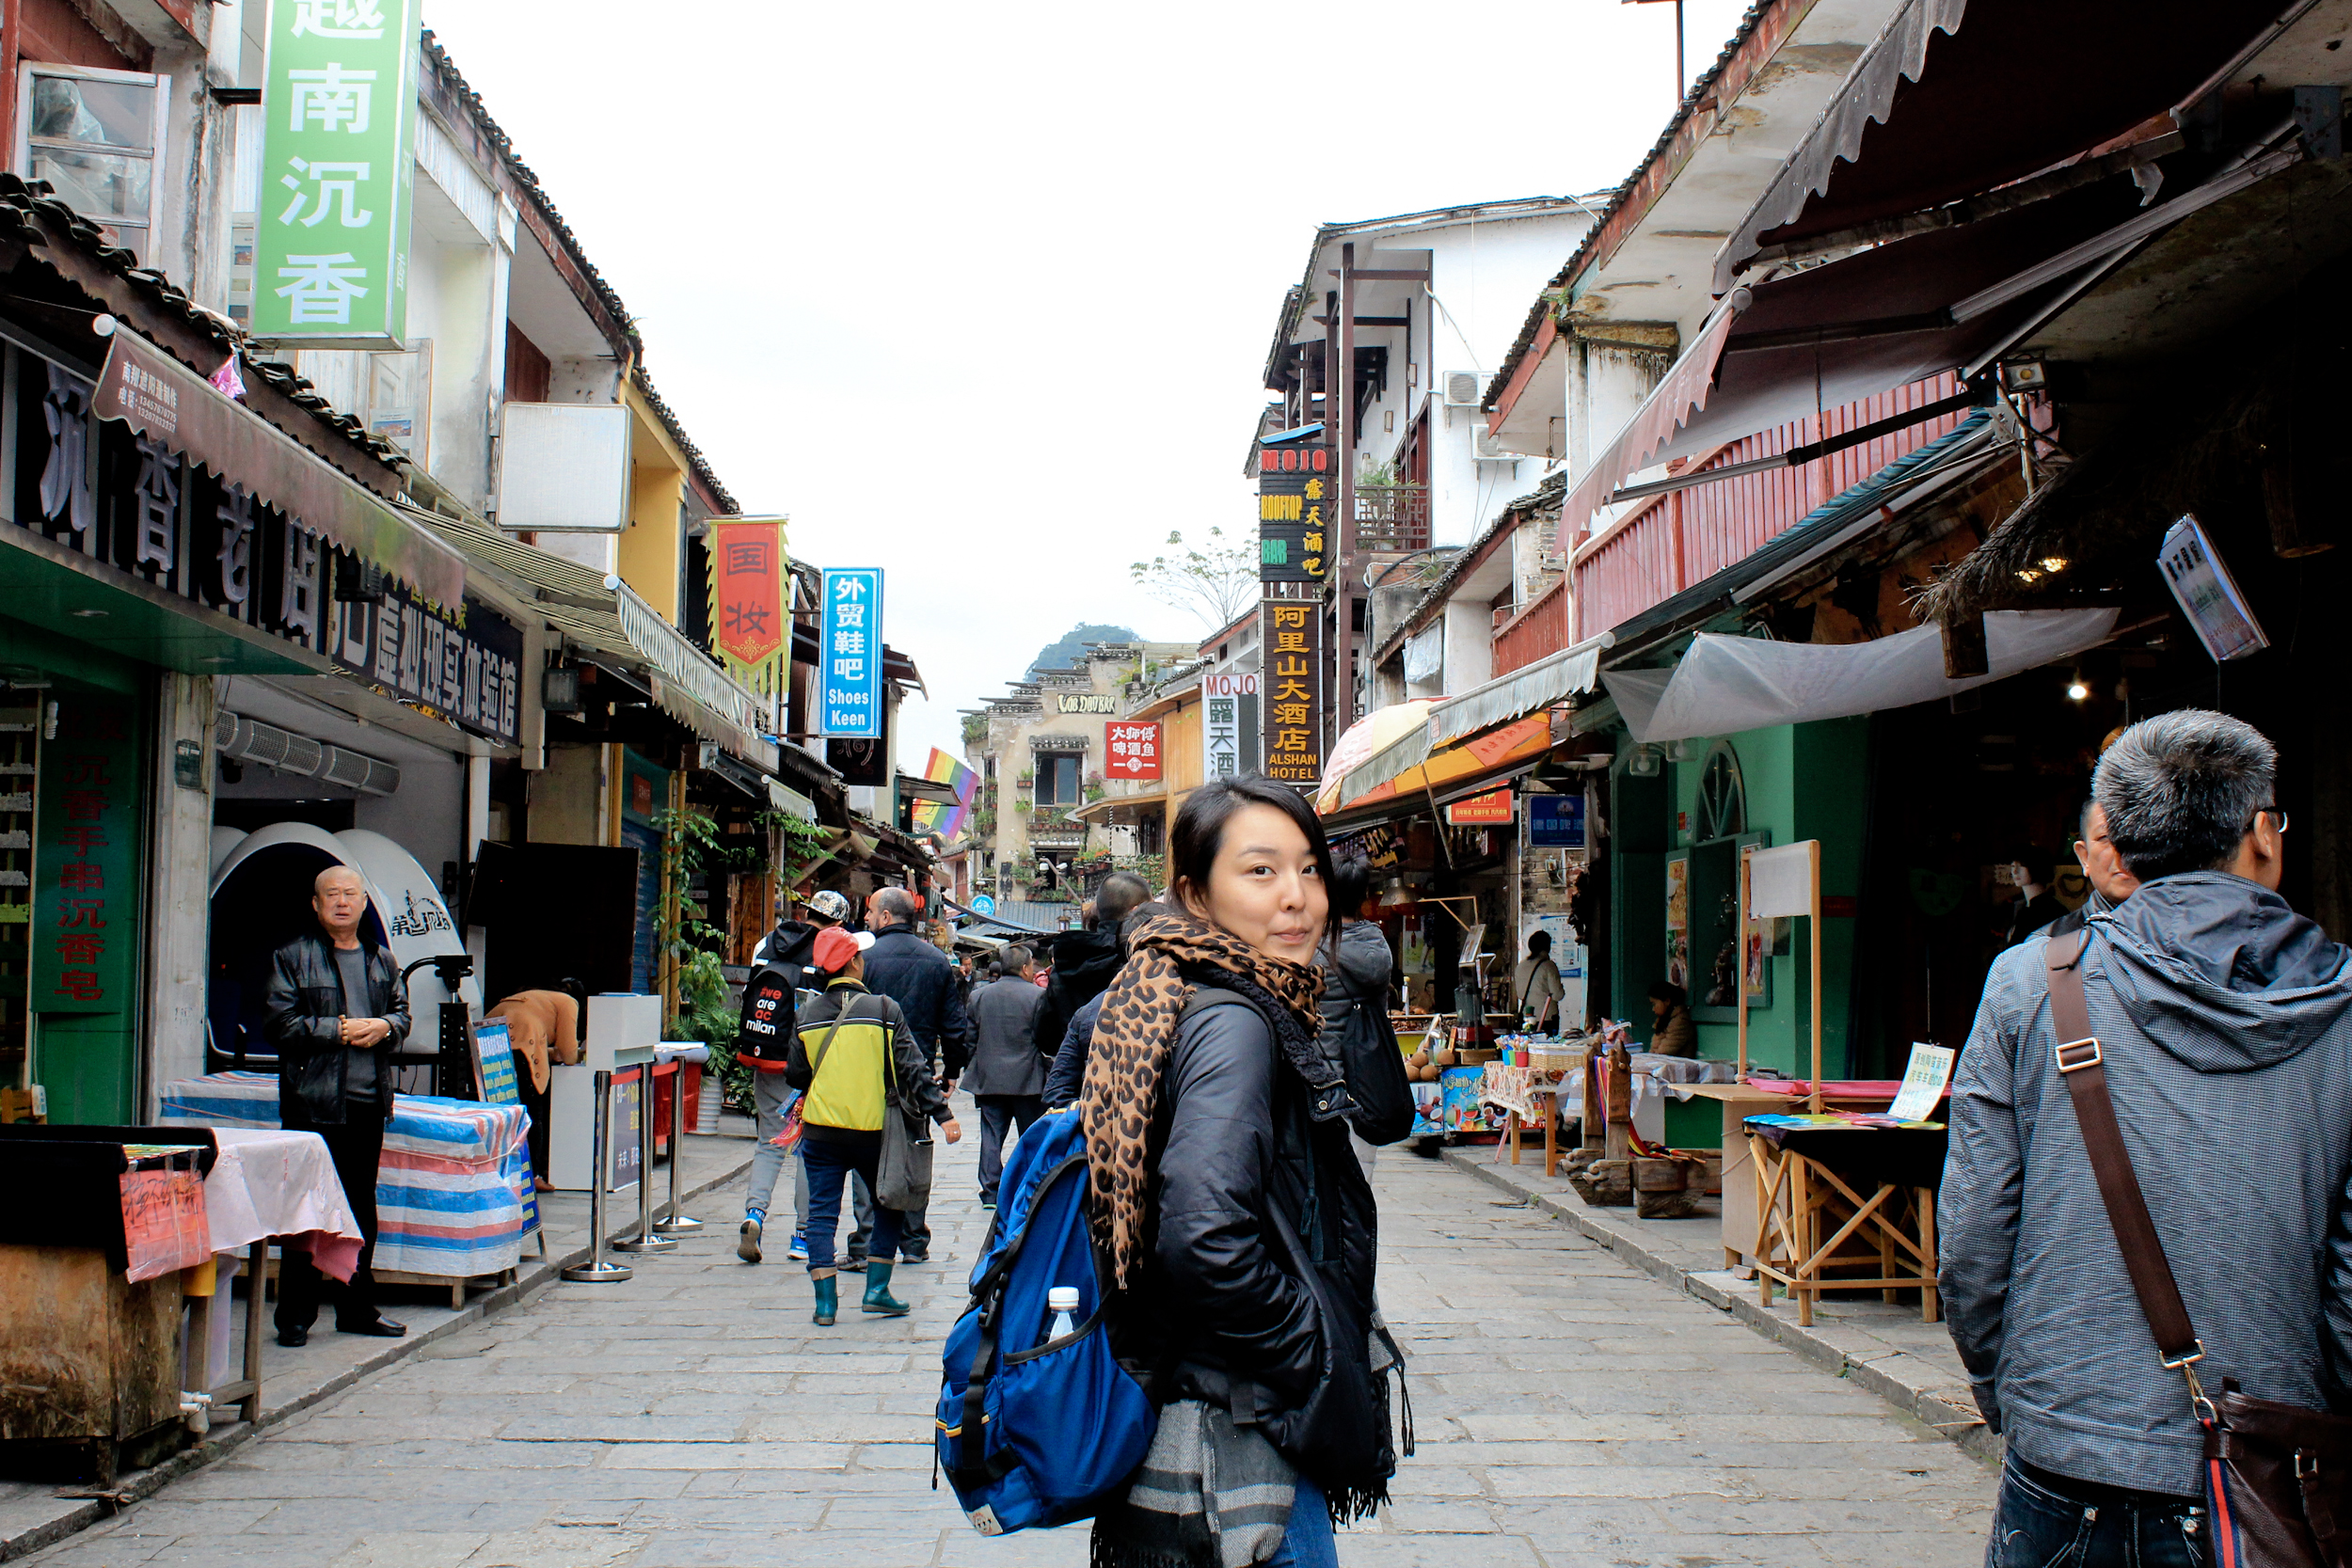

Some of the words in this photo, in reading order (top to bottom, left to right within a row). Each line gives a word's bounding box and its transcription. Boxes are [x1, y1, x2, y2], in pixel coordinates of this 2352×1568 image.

[275, 0, 385, 324] 越南沉香
[1261, 449, 1327, 471] MOJO
[1261, 494, 1303, 520] ROOFTOP
[1302, 478, 1325, 577] 露天酒吧
[1261, 539, 1287, 564] BAR
[834, 576, 866, 681] 外贸鞋吧
[1206, 674, 1257, 696] MOJO
[1273, 606, 1311, 752] 阿里山大酒店
[828, 689, 869, 705] Shoes
[832, 709, 866, 726] Keen
[1110, 725, 1156, 741] 大师傅
[1112, 741, 1155, 756] 啤酒鱼
[1270, 767, 1315, 779] HOTEL
[54, 754, 111, 1002] 沉香手串沉香皂
[759, 986, 783, 1000] #we
[756, 999, 776, 1011] are
[755, 1009, 772, 1021] ac
[745, 1020, 776, 1036] milan
